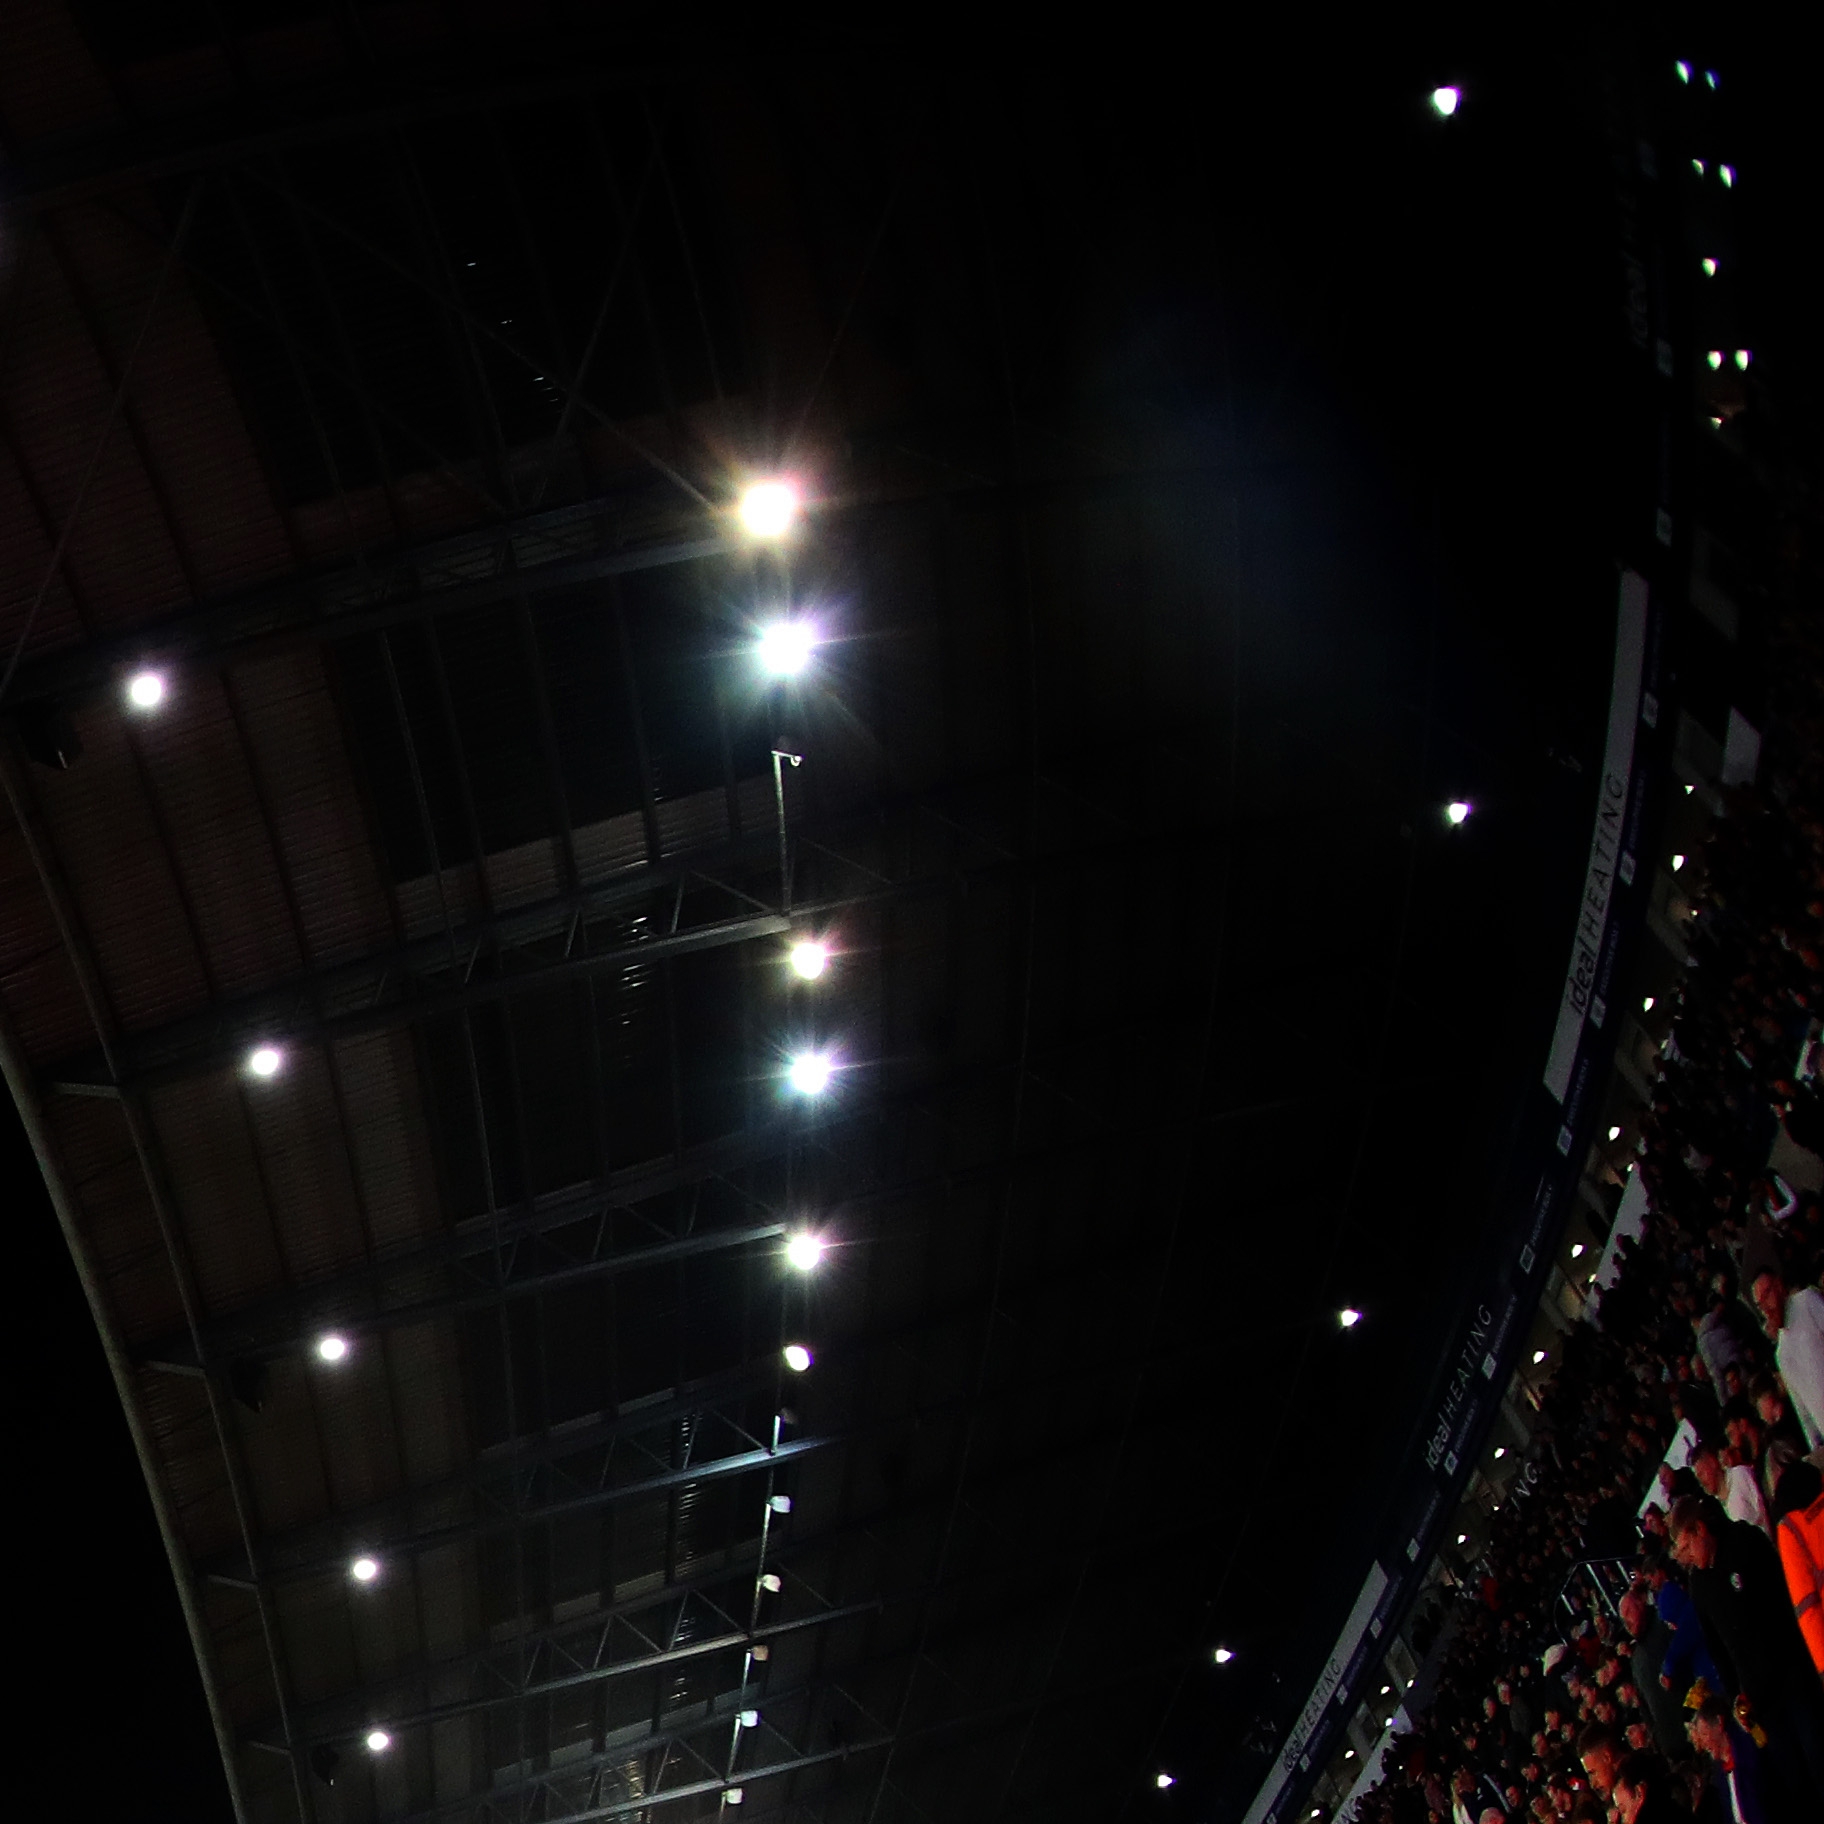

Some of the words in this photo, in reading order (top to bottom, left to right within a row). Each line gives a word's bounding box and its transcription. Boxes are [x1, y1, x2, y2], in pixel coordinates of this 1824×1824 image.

[1569, 937, 1596, 1015] ideal
[1588, 773, 1623, 938] HEATING
[1445, 1304, 1492, 1414] HEATING
